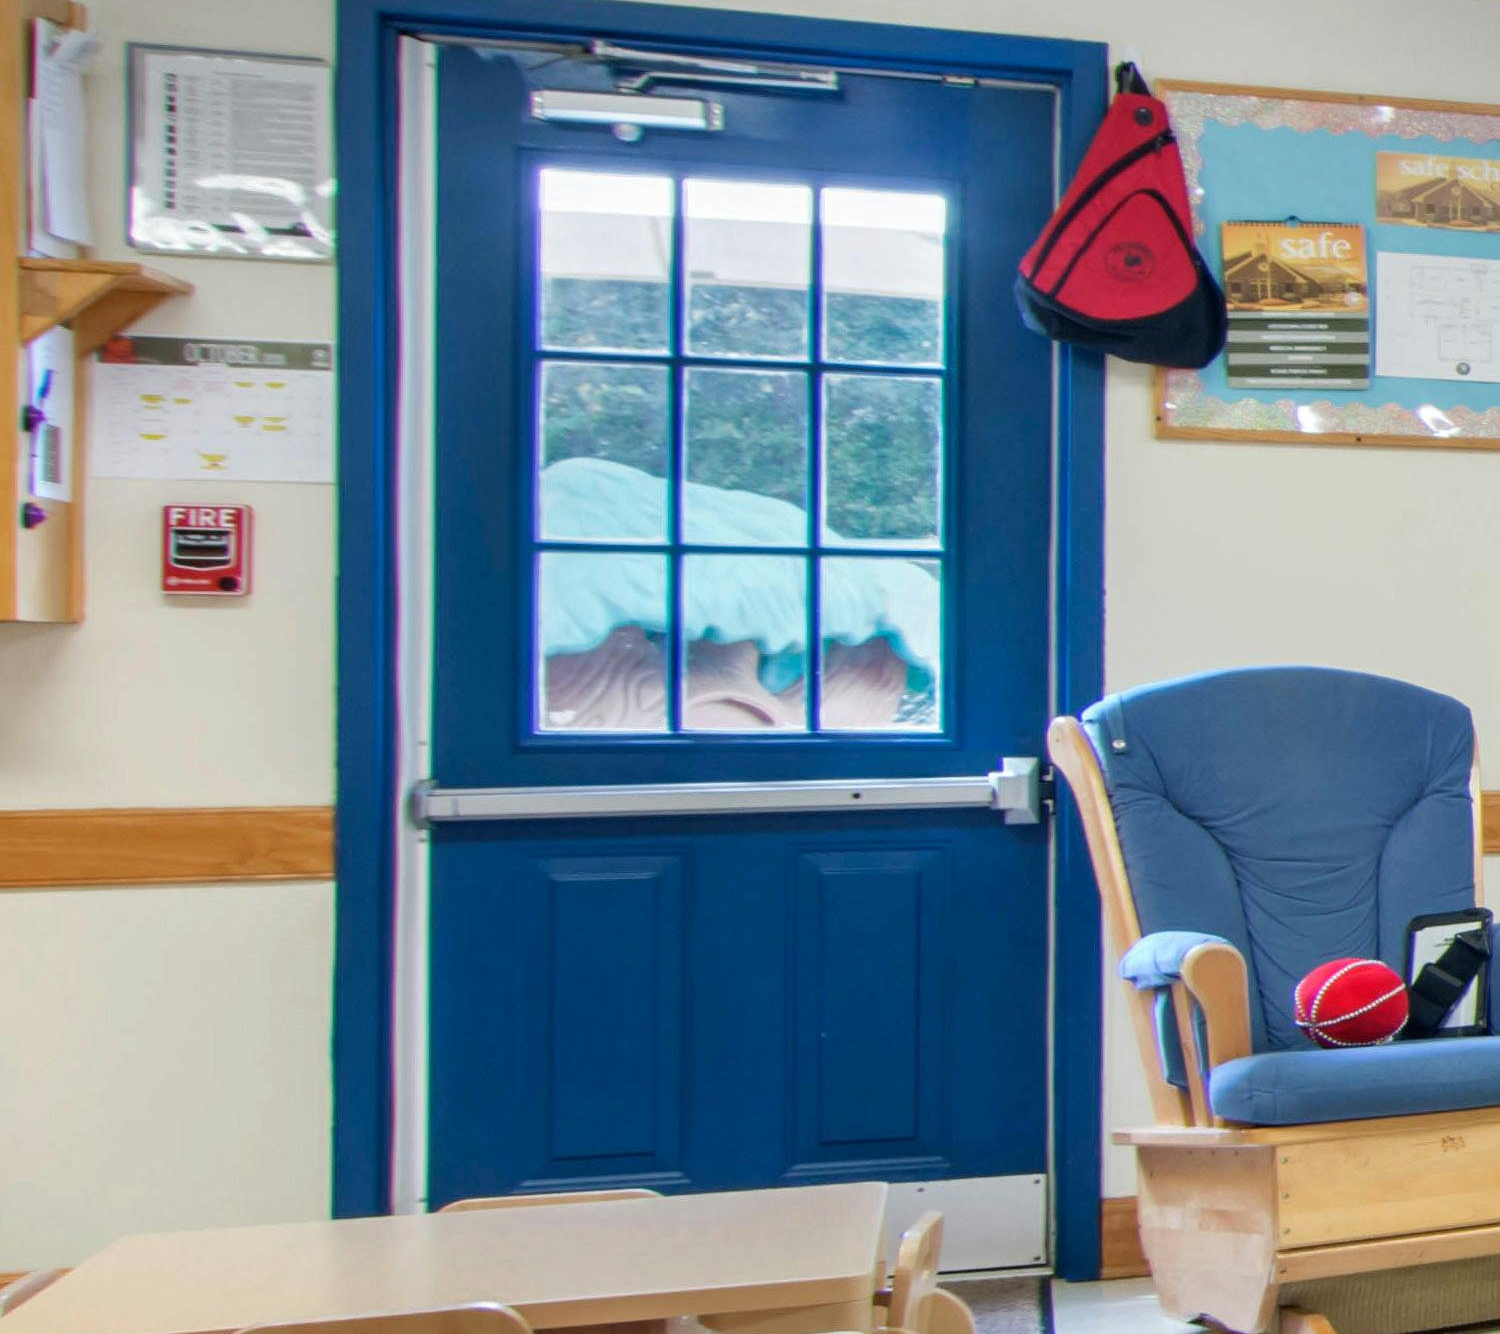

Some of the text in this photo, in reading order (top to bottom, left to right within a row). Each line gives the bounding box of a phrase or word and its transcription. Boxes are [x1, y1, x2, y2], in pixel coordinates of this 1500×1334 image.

[1399, 155, 1447, 178] safe
[1279, 231, 1352, 260] safe
[168, 507, 237, 527] FIRE
